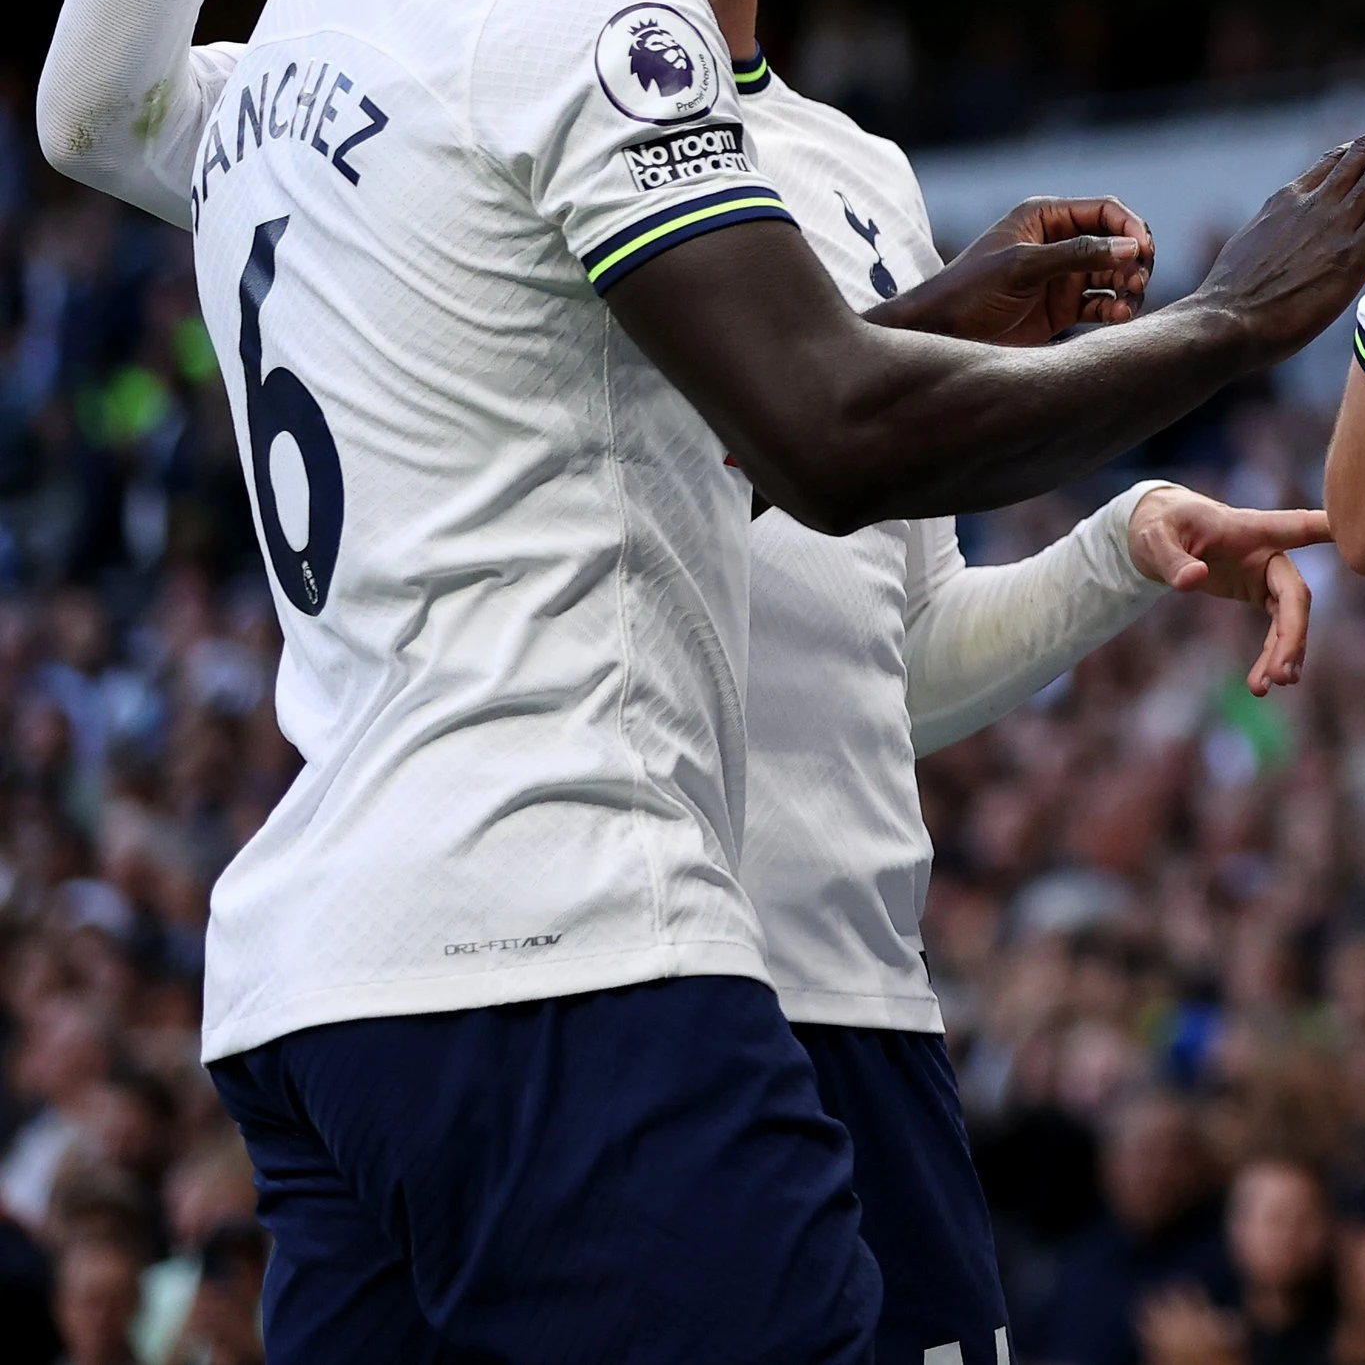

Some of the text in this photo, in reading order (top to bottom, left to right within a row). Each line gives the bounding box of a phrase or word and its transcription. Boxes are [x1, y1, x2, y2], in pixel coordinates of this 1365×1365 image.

[623, 130, 737, 171] No room
[631, 152, 752, 193] for racism
[239, 214, 345, 618] 6
